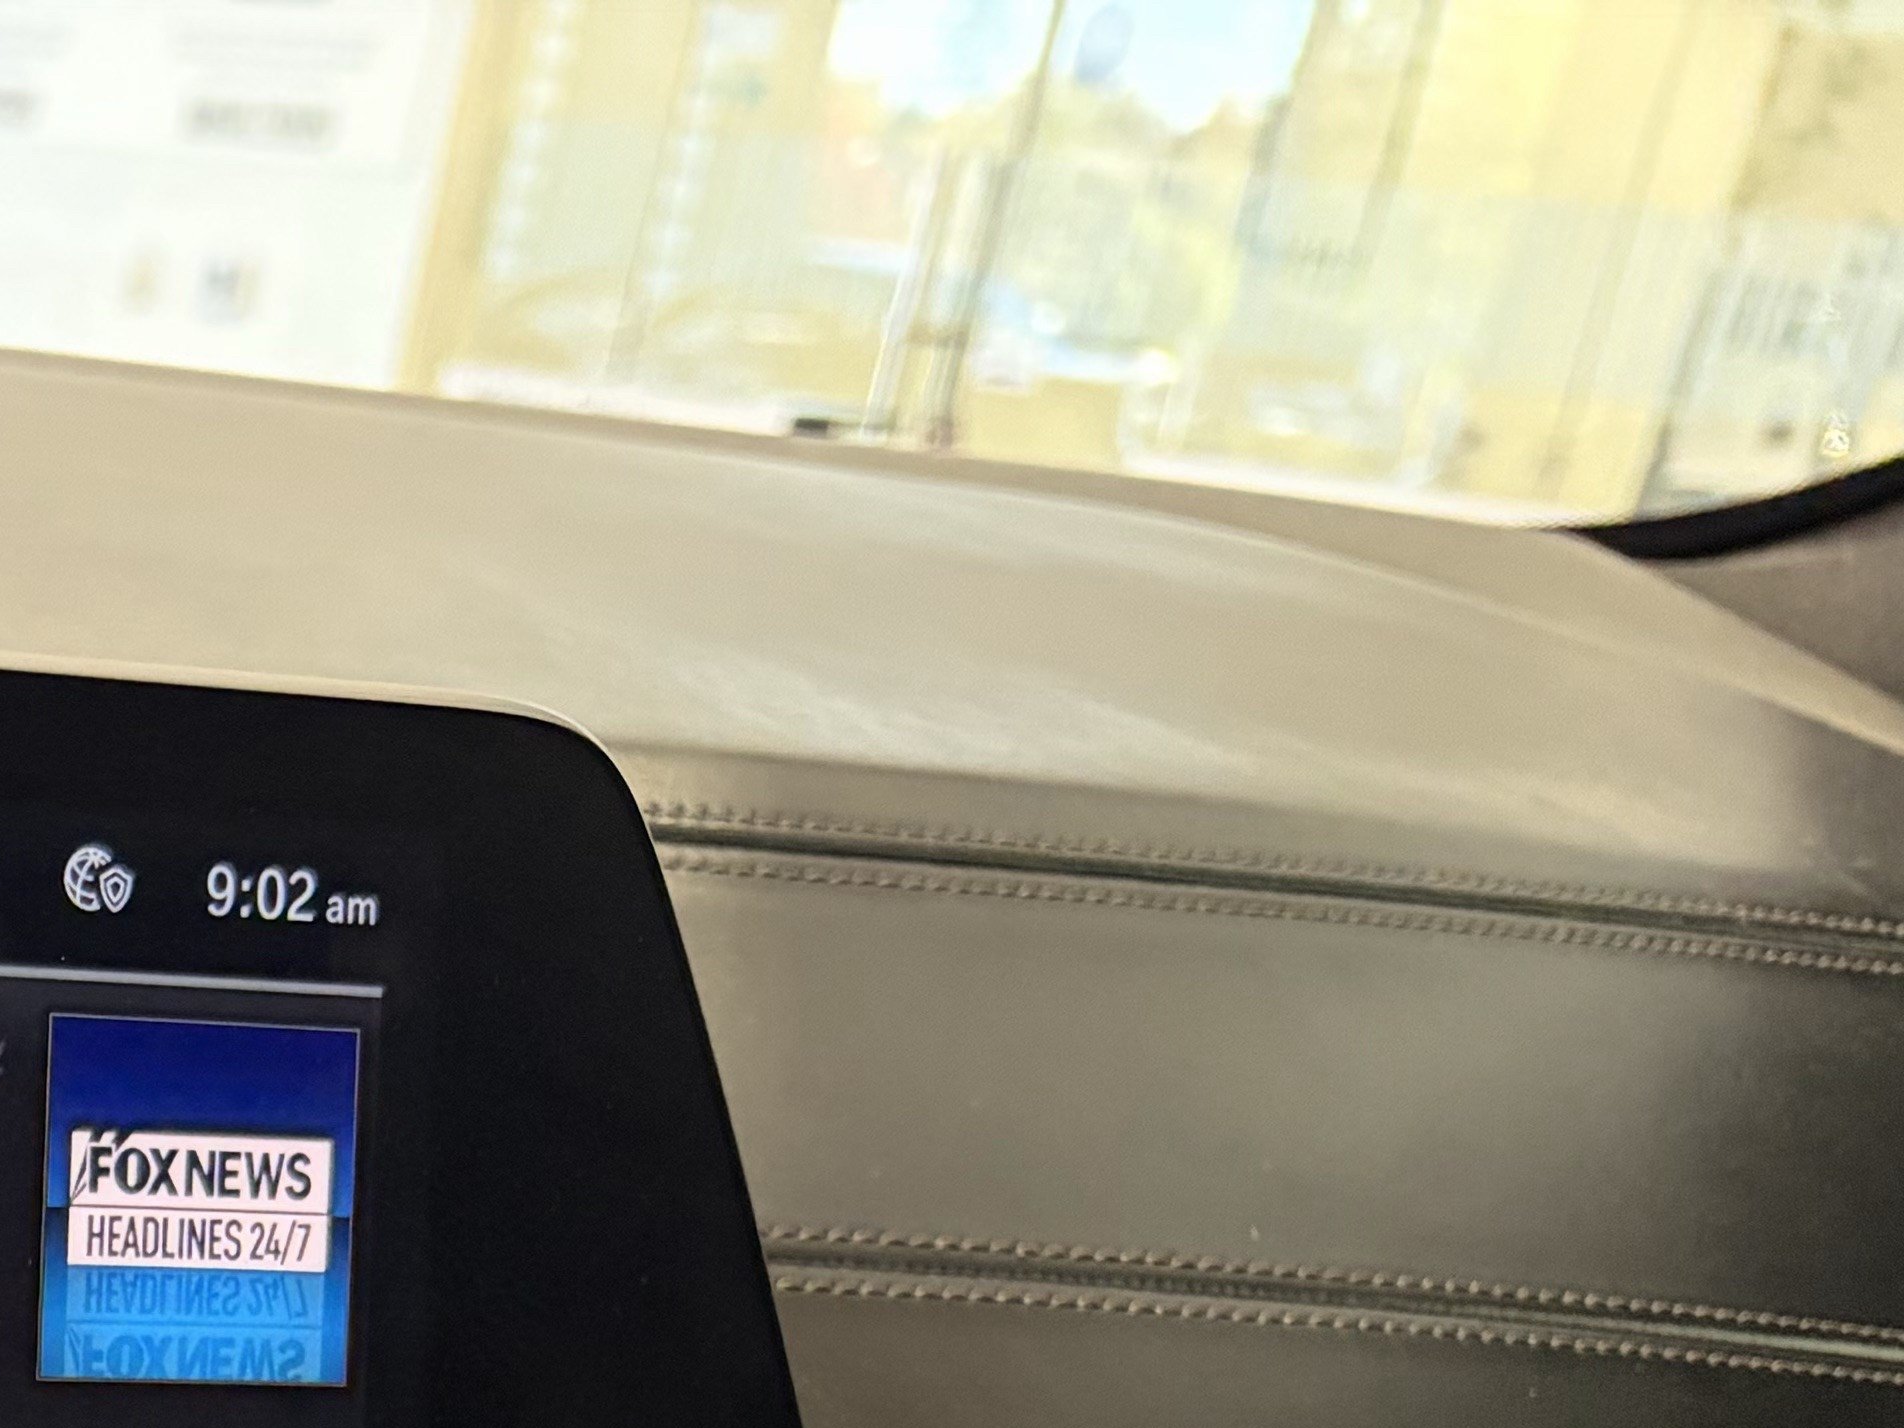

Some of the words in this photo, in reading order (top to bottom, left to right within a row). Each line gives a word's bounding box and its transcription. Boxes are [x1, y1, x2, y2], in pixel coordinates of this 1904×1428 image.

[207, 864, 316, 922] 9:02
[325, 895, 377, 926] am
[86, 1215, 242, 1261] HEADLINES
[249, 1219, 312, 1265] 24/7
